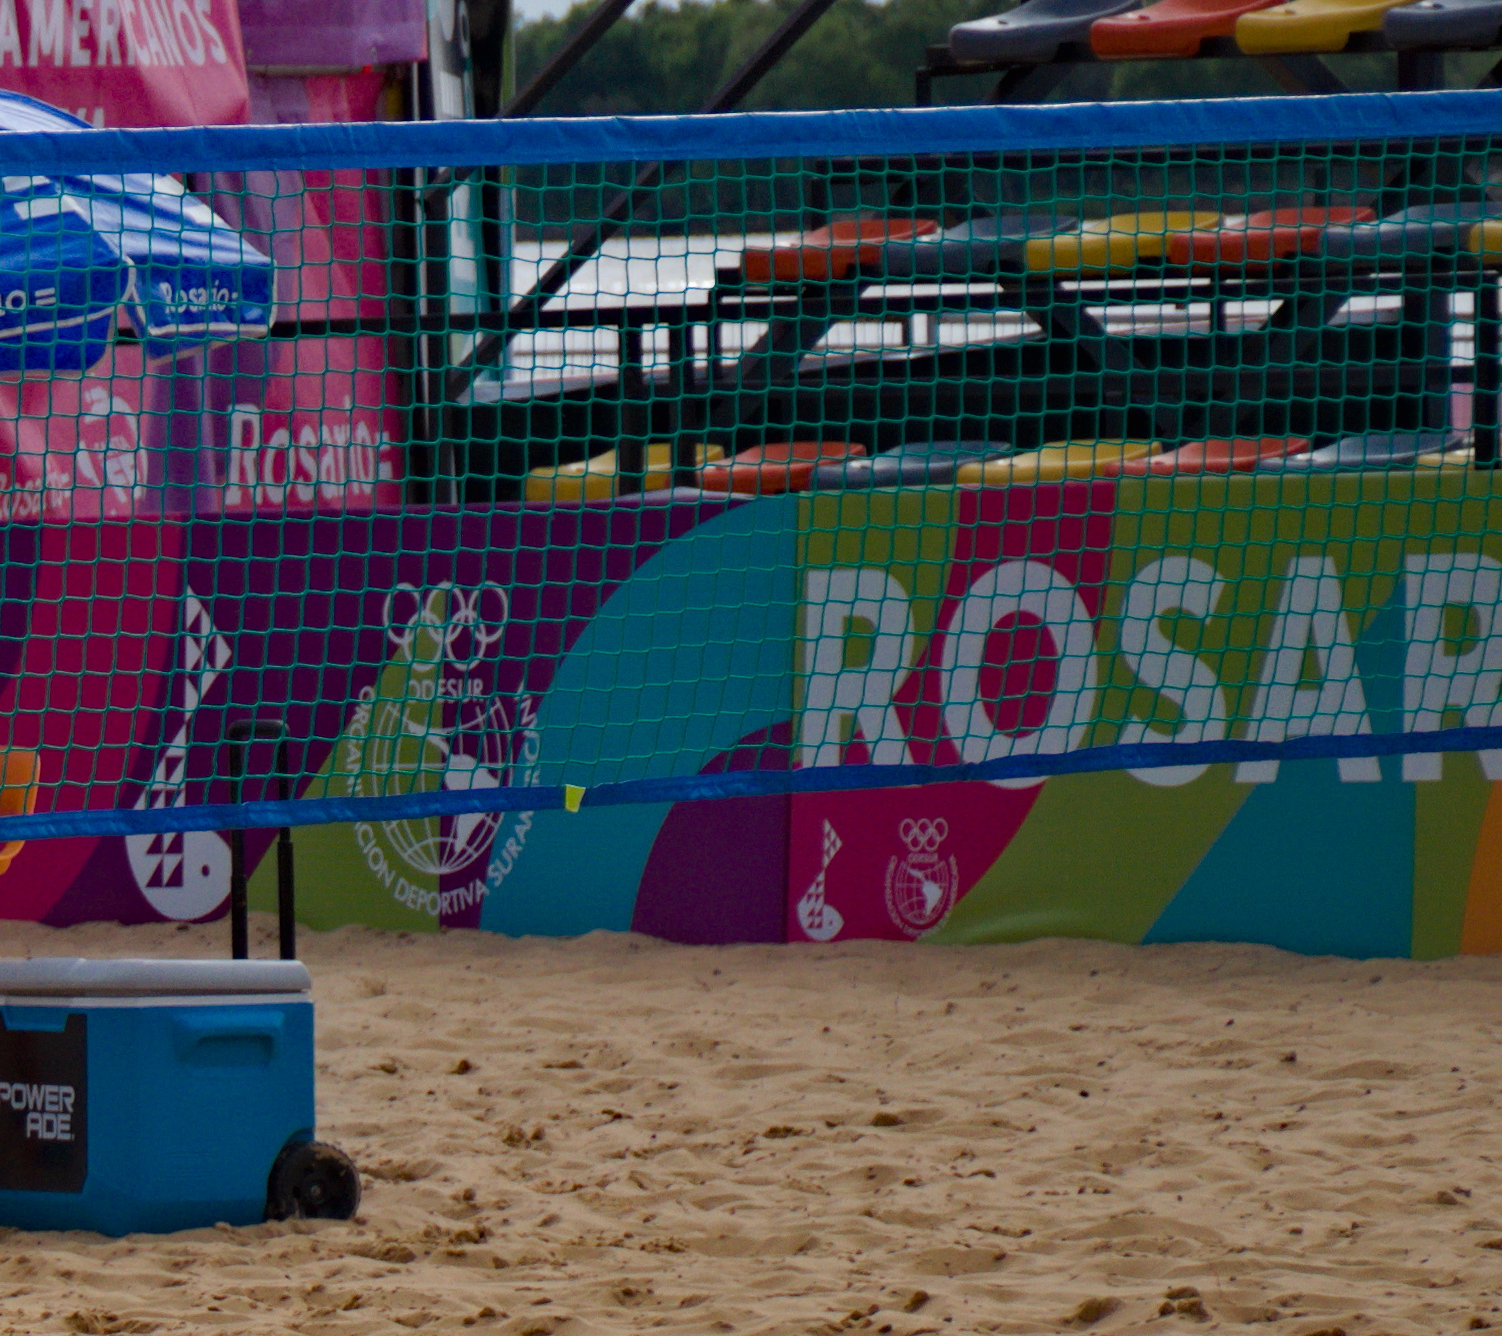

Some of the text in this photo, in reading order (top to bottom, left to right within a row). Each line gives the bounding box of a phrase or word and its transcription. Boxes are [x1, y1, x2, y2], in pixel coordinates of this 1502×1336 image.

[800, 552, 1502, 790] ROSAR
[408, 678, 484, 704] ODESUR
[26, 1114, 73, 1139] ADE
